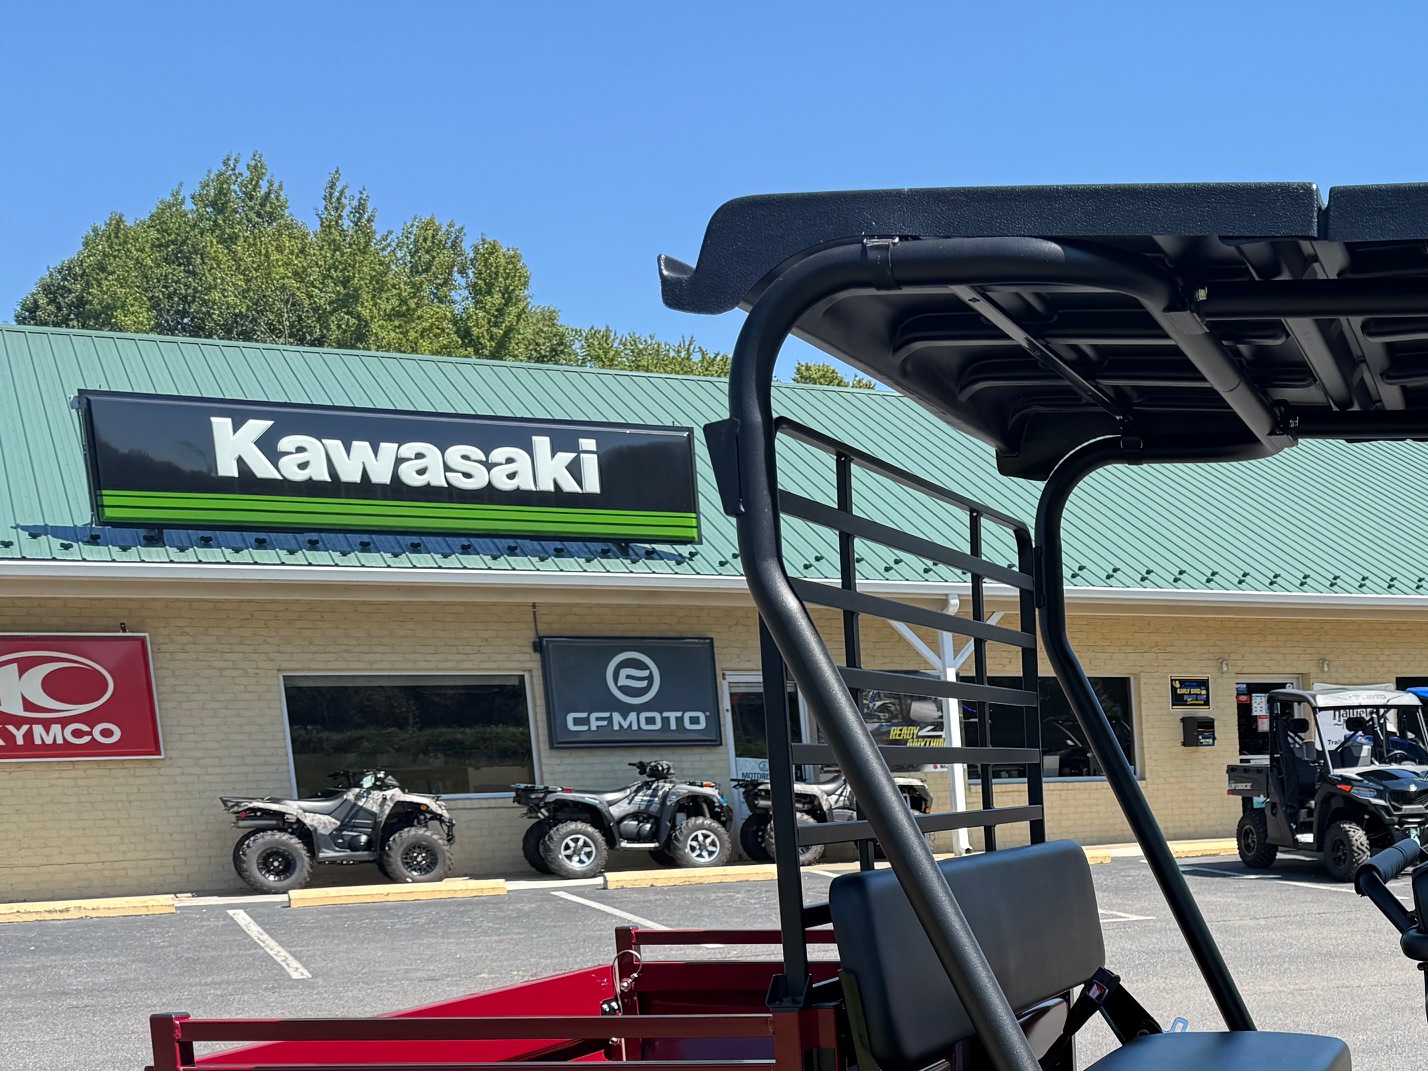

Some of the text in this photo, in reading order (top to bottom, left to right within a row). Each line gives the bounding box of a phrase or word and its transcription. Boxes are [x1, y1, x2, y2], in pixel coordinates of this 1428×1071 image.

[210, 416, 602, 495] Kawasaki
[566, 711, 706, 731] CFMOTO
[0, 723, 122, 745] YMCO
[890, 726, 920, 739] READY
